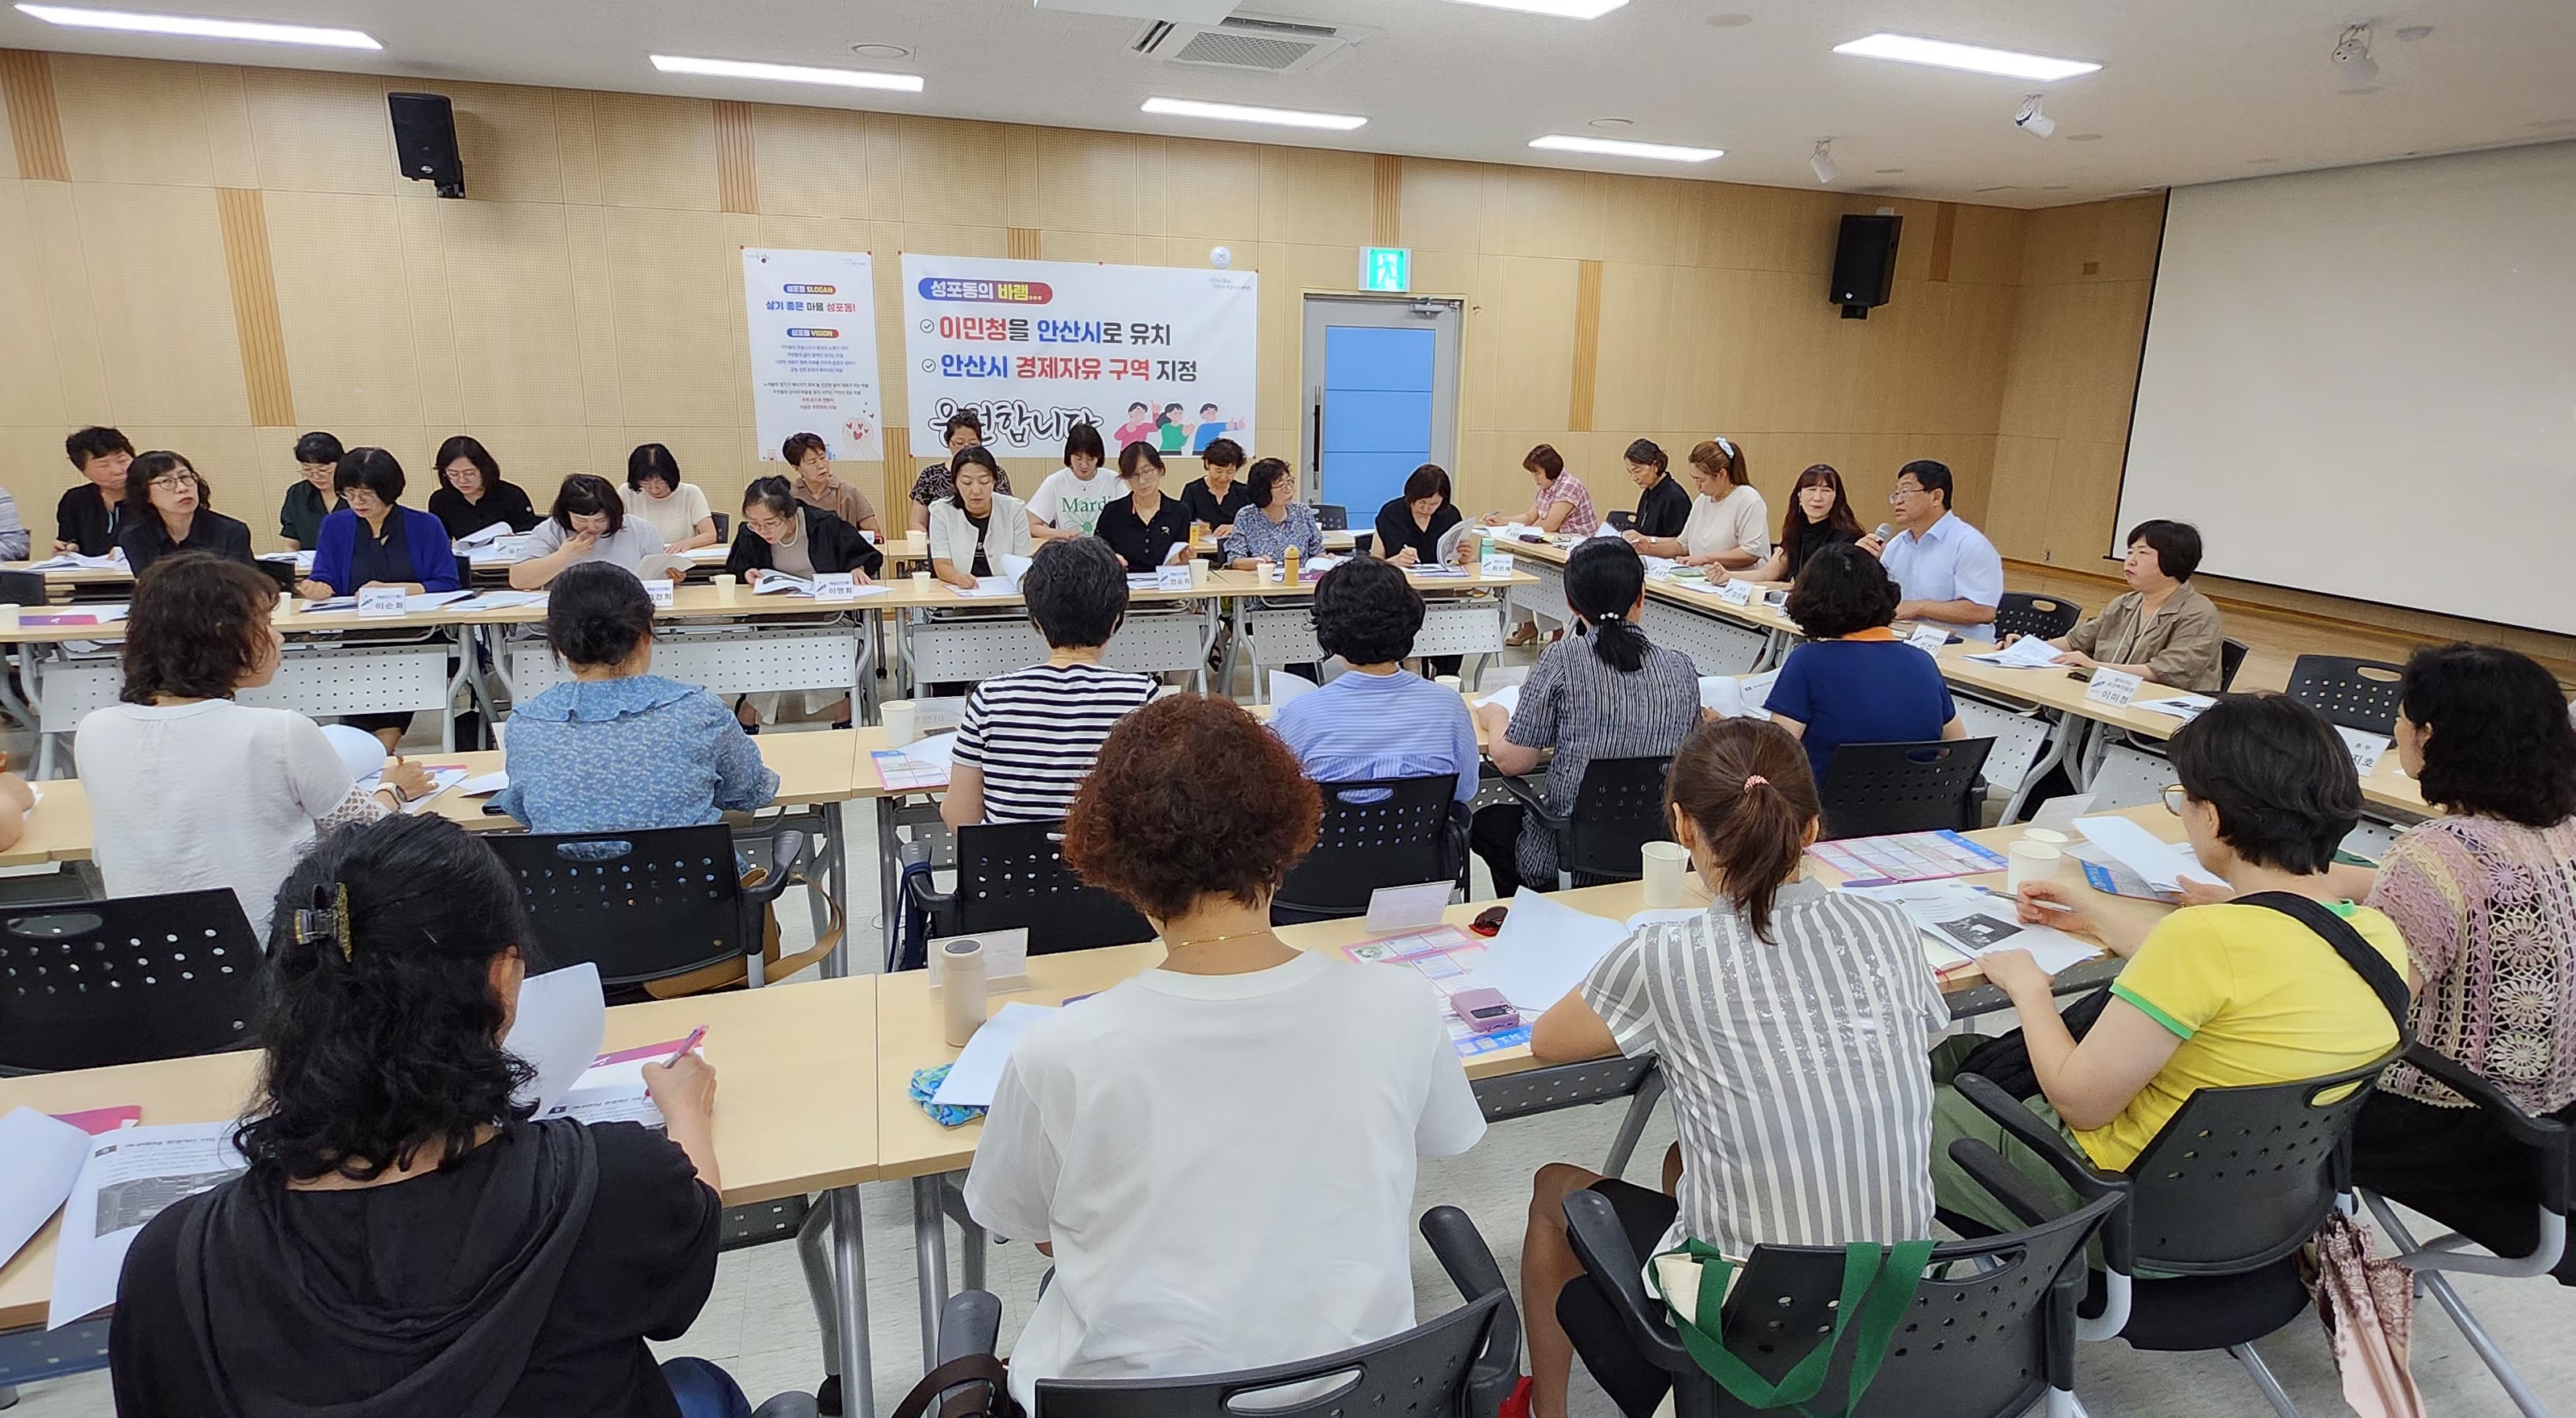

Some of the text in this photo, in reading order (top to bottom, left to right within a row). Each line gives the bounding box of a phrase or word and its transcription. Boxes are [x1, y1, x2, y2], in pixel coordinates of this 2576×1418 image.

[807, 286, 834, 294] SLOGAN
[930, 280, 994, 300] 성포동의
[766, 300, 856, 313] 살기 좋은 마을 성포동!
[811, 329, 833, 337] VISION
[939, 315, 1171, 346] 이민청을 안산시로 유치
[941, 353, 1197, 382] 안산시 경제자유 구역 지정
[2102, 690, 2129, 705] 이미정
[2353, 753, 2375, 768] 지호
